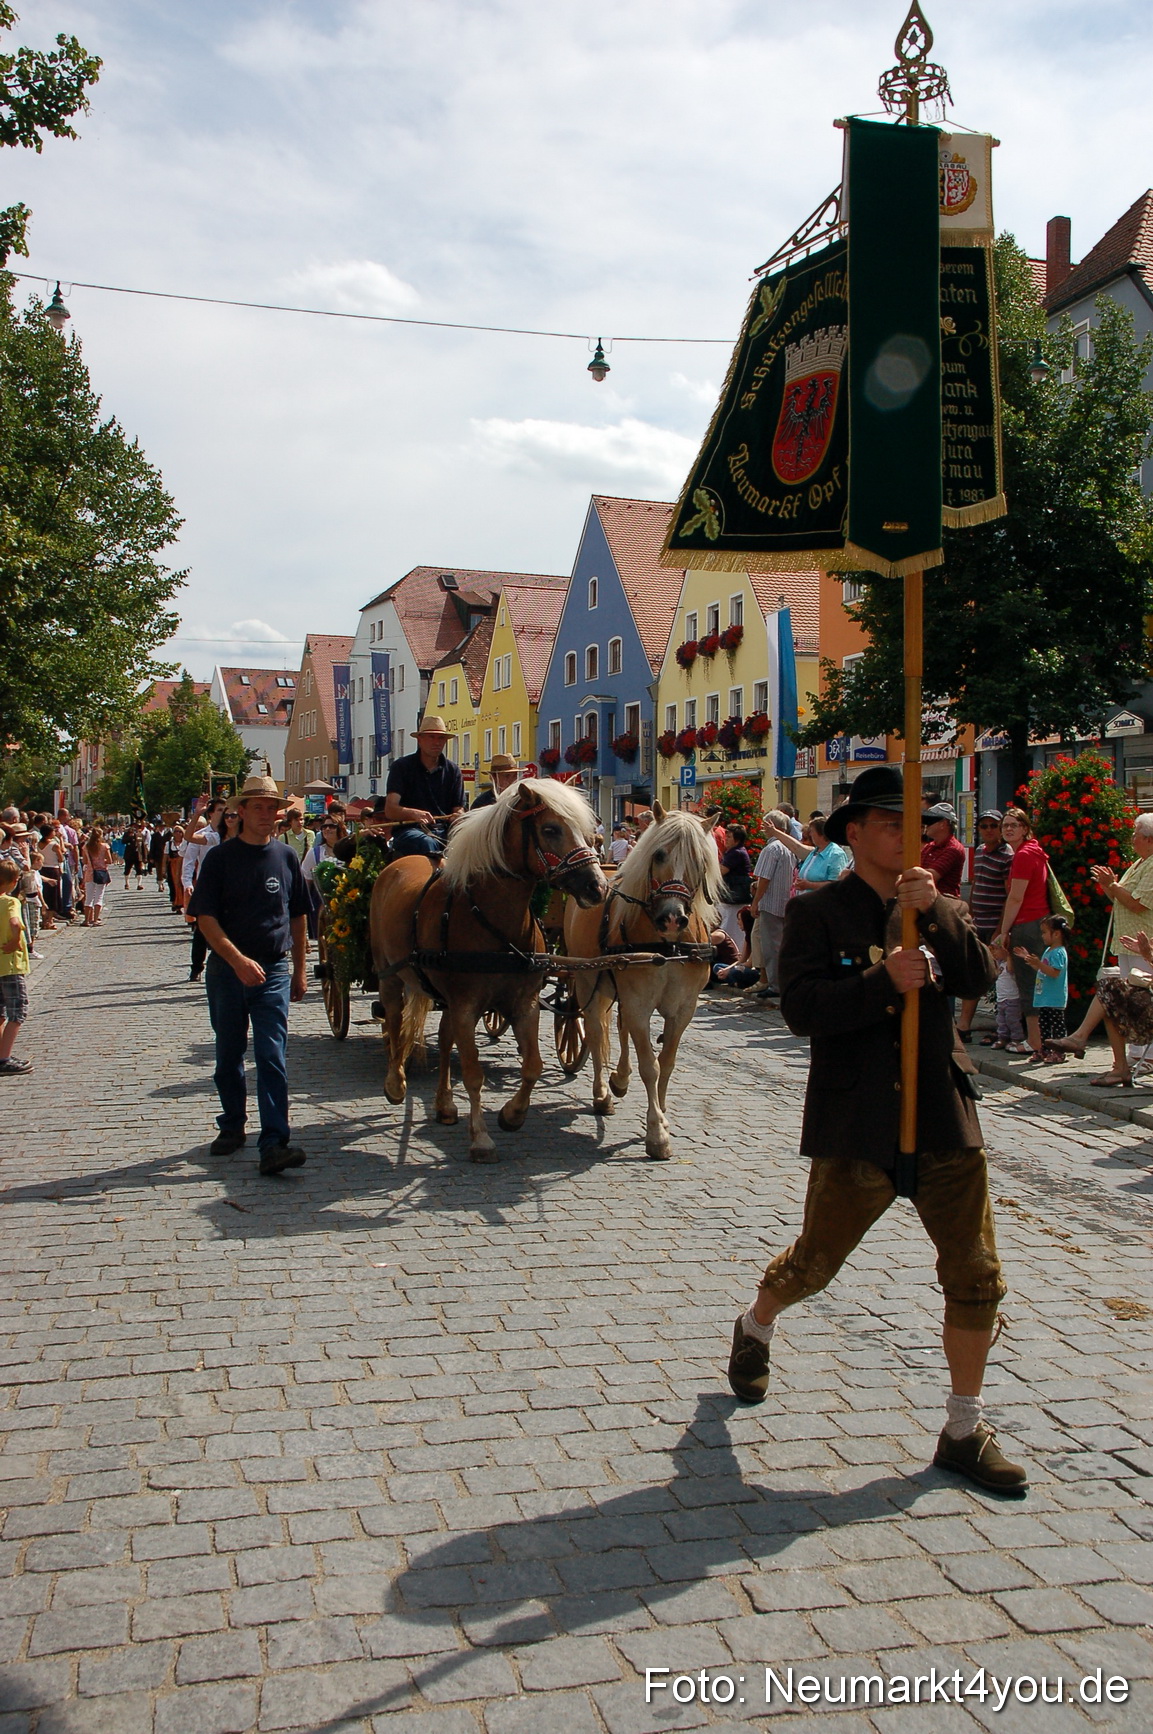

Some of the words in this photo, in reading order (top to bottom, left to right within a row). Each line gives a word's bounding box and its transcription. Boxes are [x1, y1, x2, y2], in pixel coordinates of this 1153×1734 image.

[940, 263, 975, 275] serem
[940, 283, 978, 304] aten
[944, 378, 979, 398] ank
[728, 443, 803, 518] Neumarkt
[941, 463, 983, 479] emau
[380, 694, 388, 730] RUPPERT
[683, 768, 693, 785] P
